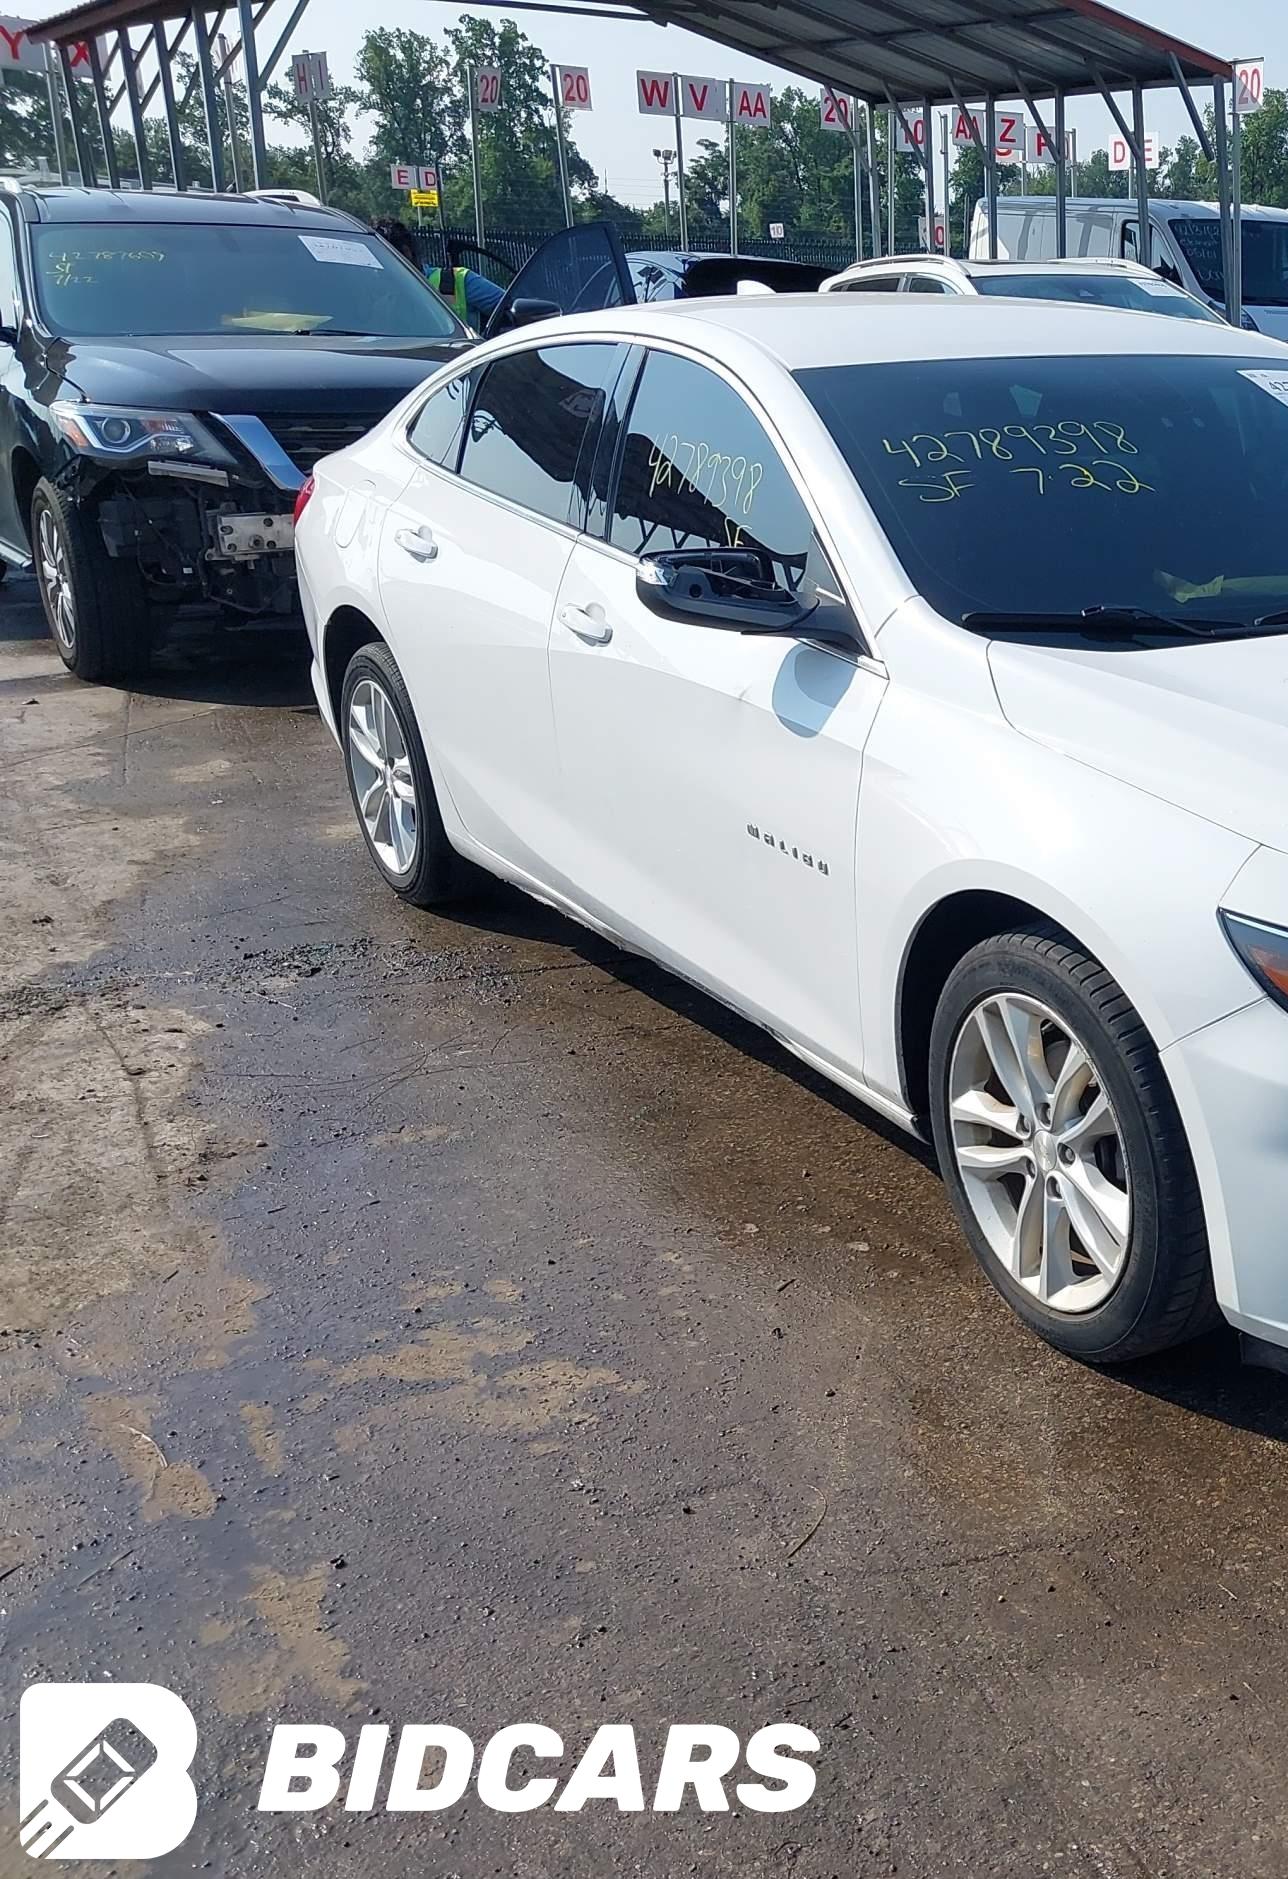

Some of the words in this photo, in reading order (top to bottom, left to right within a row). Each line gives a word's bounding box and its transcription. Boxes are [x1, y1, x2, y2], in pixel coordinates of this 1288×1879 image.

[0, 24, 24, 60] Y
[480, 74, 499, 104] 20
[564, 73, 588, 103] 20
[640, 78, 669, 108] W
[688, 83, 708, 112] V
[1239, 68, 1261, 105] 20
[738, 90, 767, 119] AA
[823, 96, 849, 124] 20
[1000, 118, 1016, 143] Z
[1113, 140, 1126, 164] D
[397, 169, 410, 185] E
[424, 171, 436, 187] D
[882, 421, 1138, 467] 42789398
